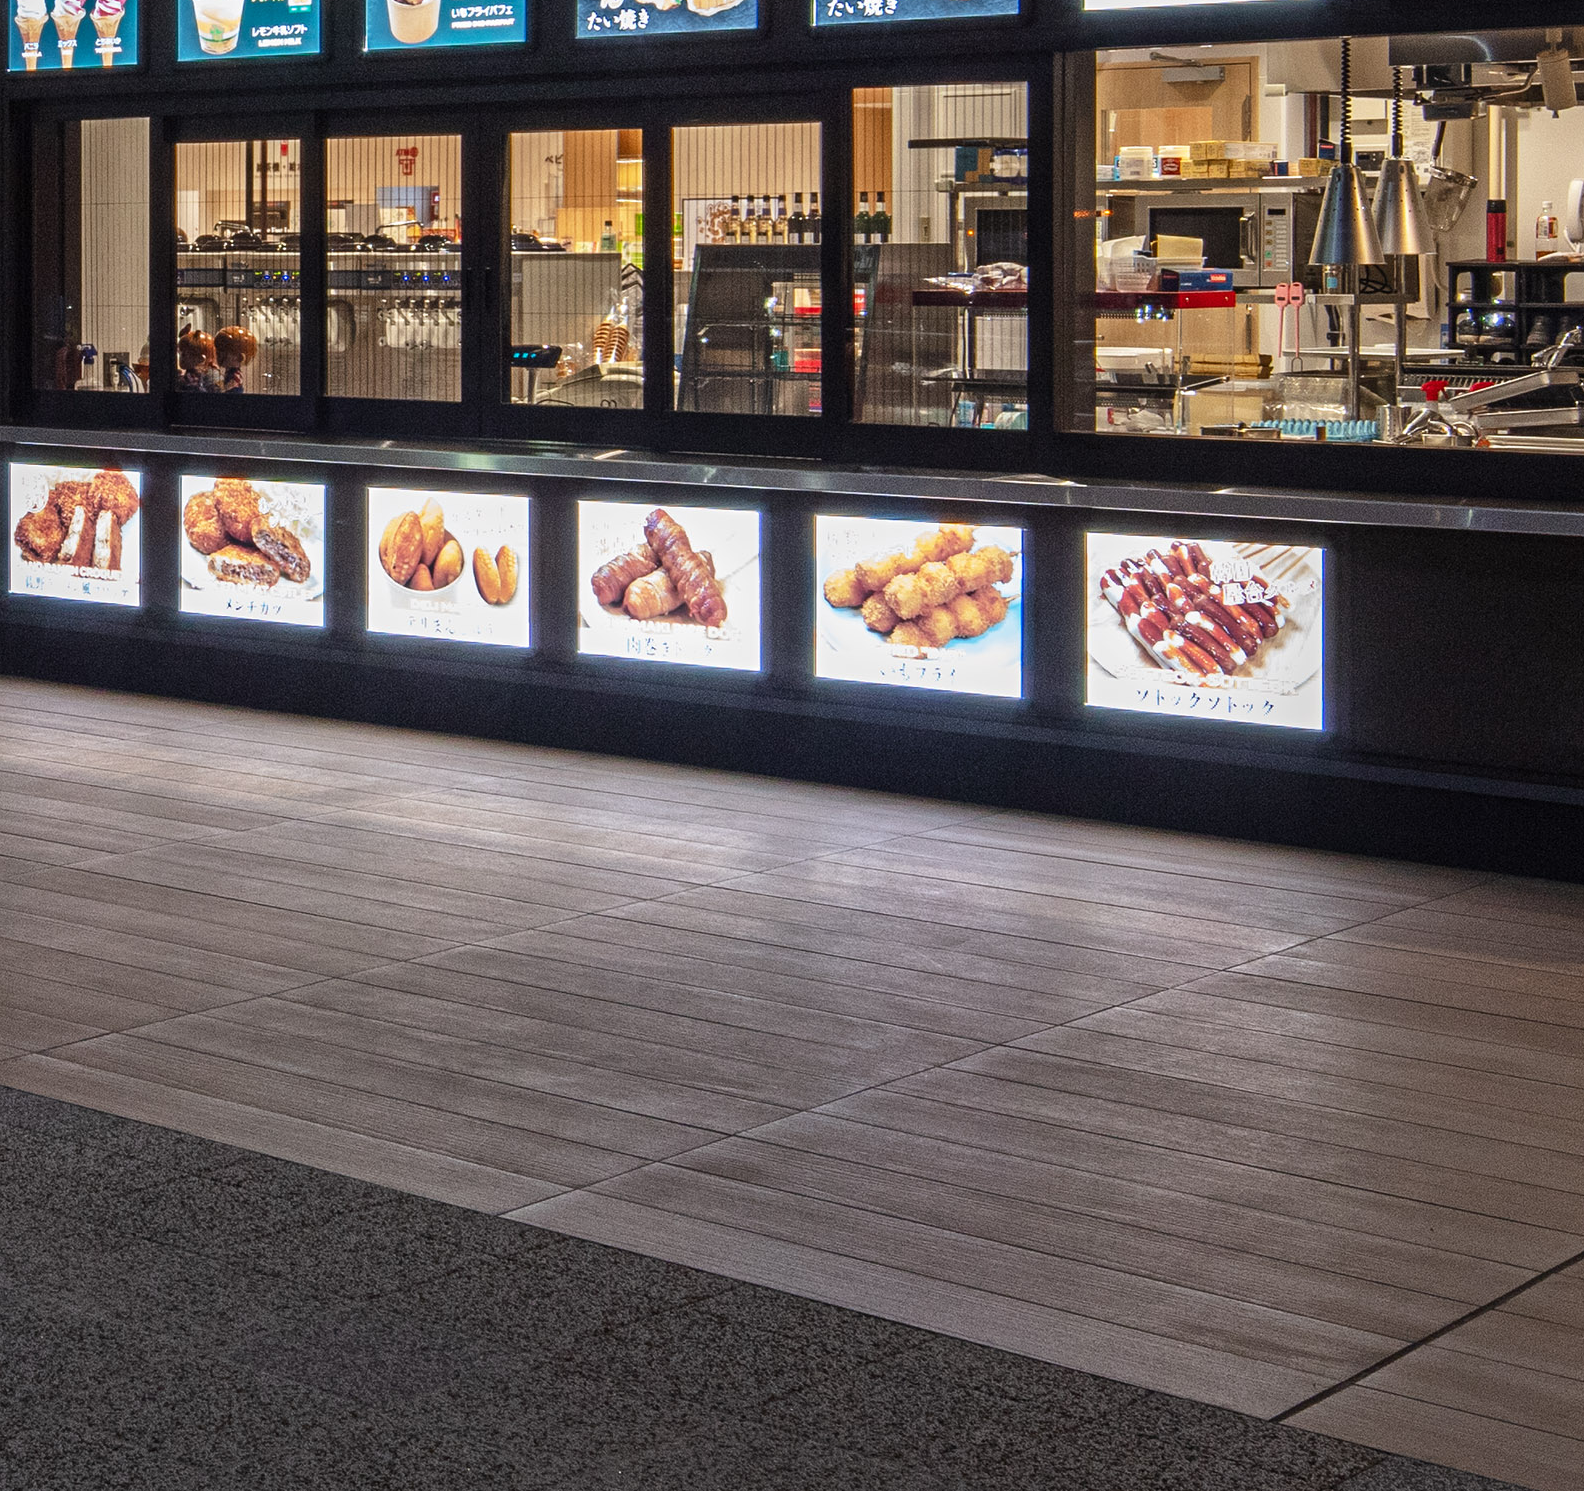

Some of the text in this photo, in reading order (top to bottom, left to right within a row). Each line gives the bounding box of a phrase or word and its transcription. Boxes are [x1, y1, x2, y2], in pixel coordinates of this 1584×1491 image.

[587, 8, 649, 31] たい焼き
[251, 23, 308, 37] レモン牛乳ソフト
[226, 598, 282, 615] メンチカツ
[1136, 689, 1275, 716] ソトックソトック
